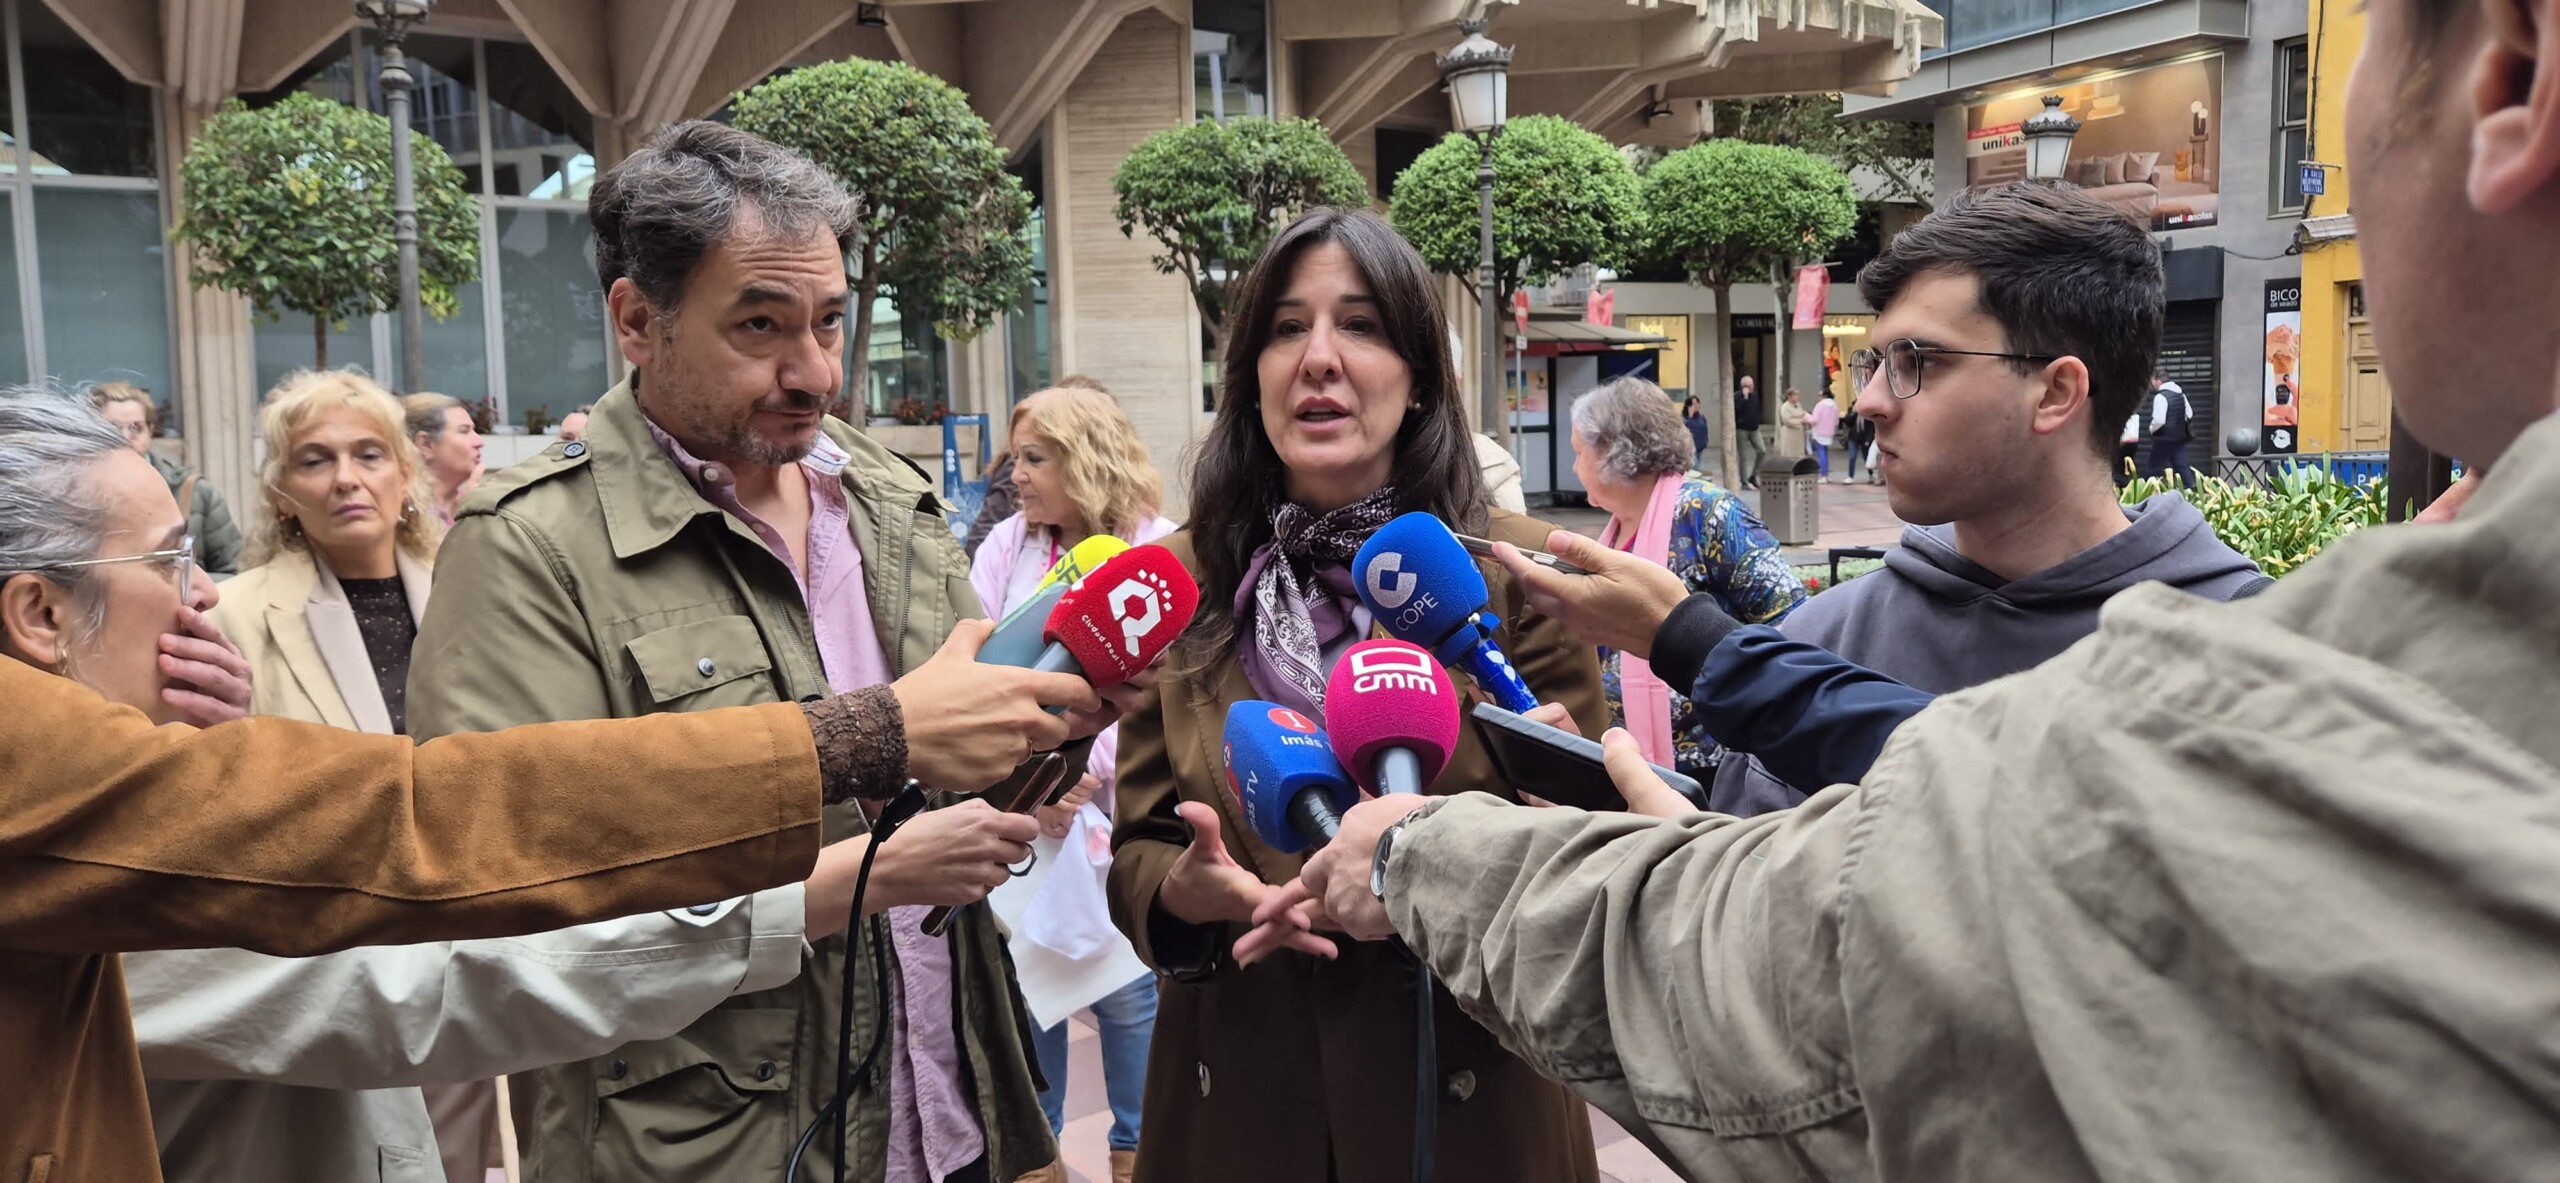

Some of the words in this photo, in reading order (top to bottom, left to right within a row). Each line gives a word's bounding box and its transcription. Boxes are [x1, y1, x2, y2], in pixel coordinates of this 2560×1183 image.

[2270, 288, 2299, 301] BICO
[1395, 591, 1439, 631] COPE
[1353, 672, 1438, 696] cmm
[1246, 769, 1259, 795] TV
